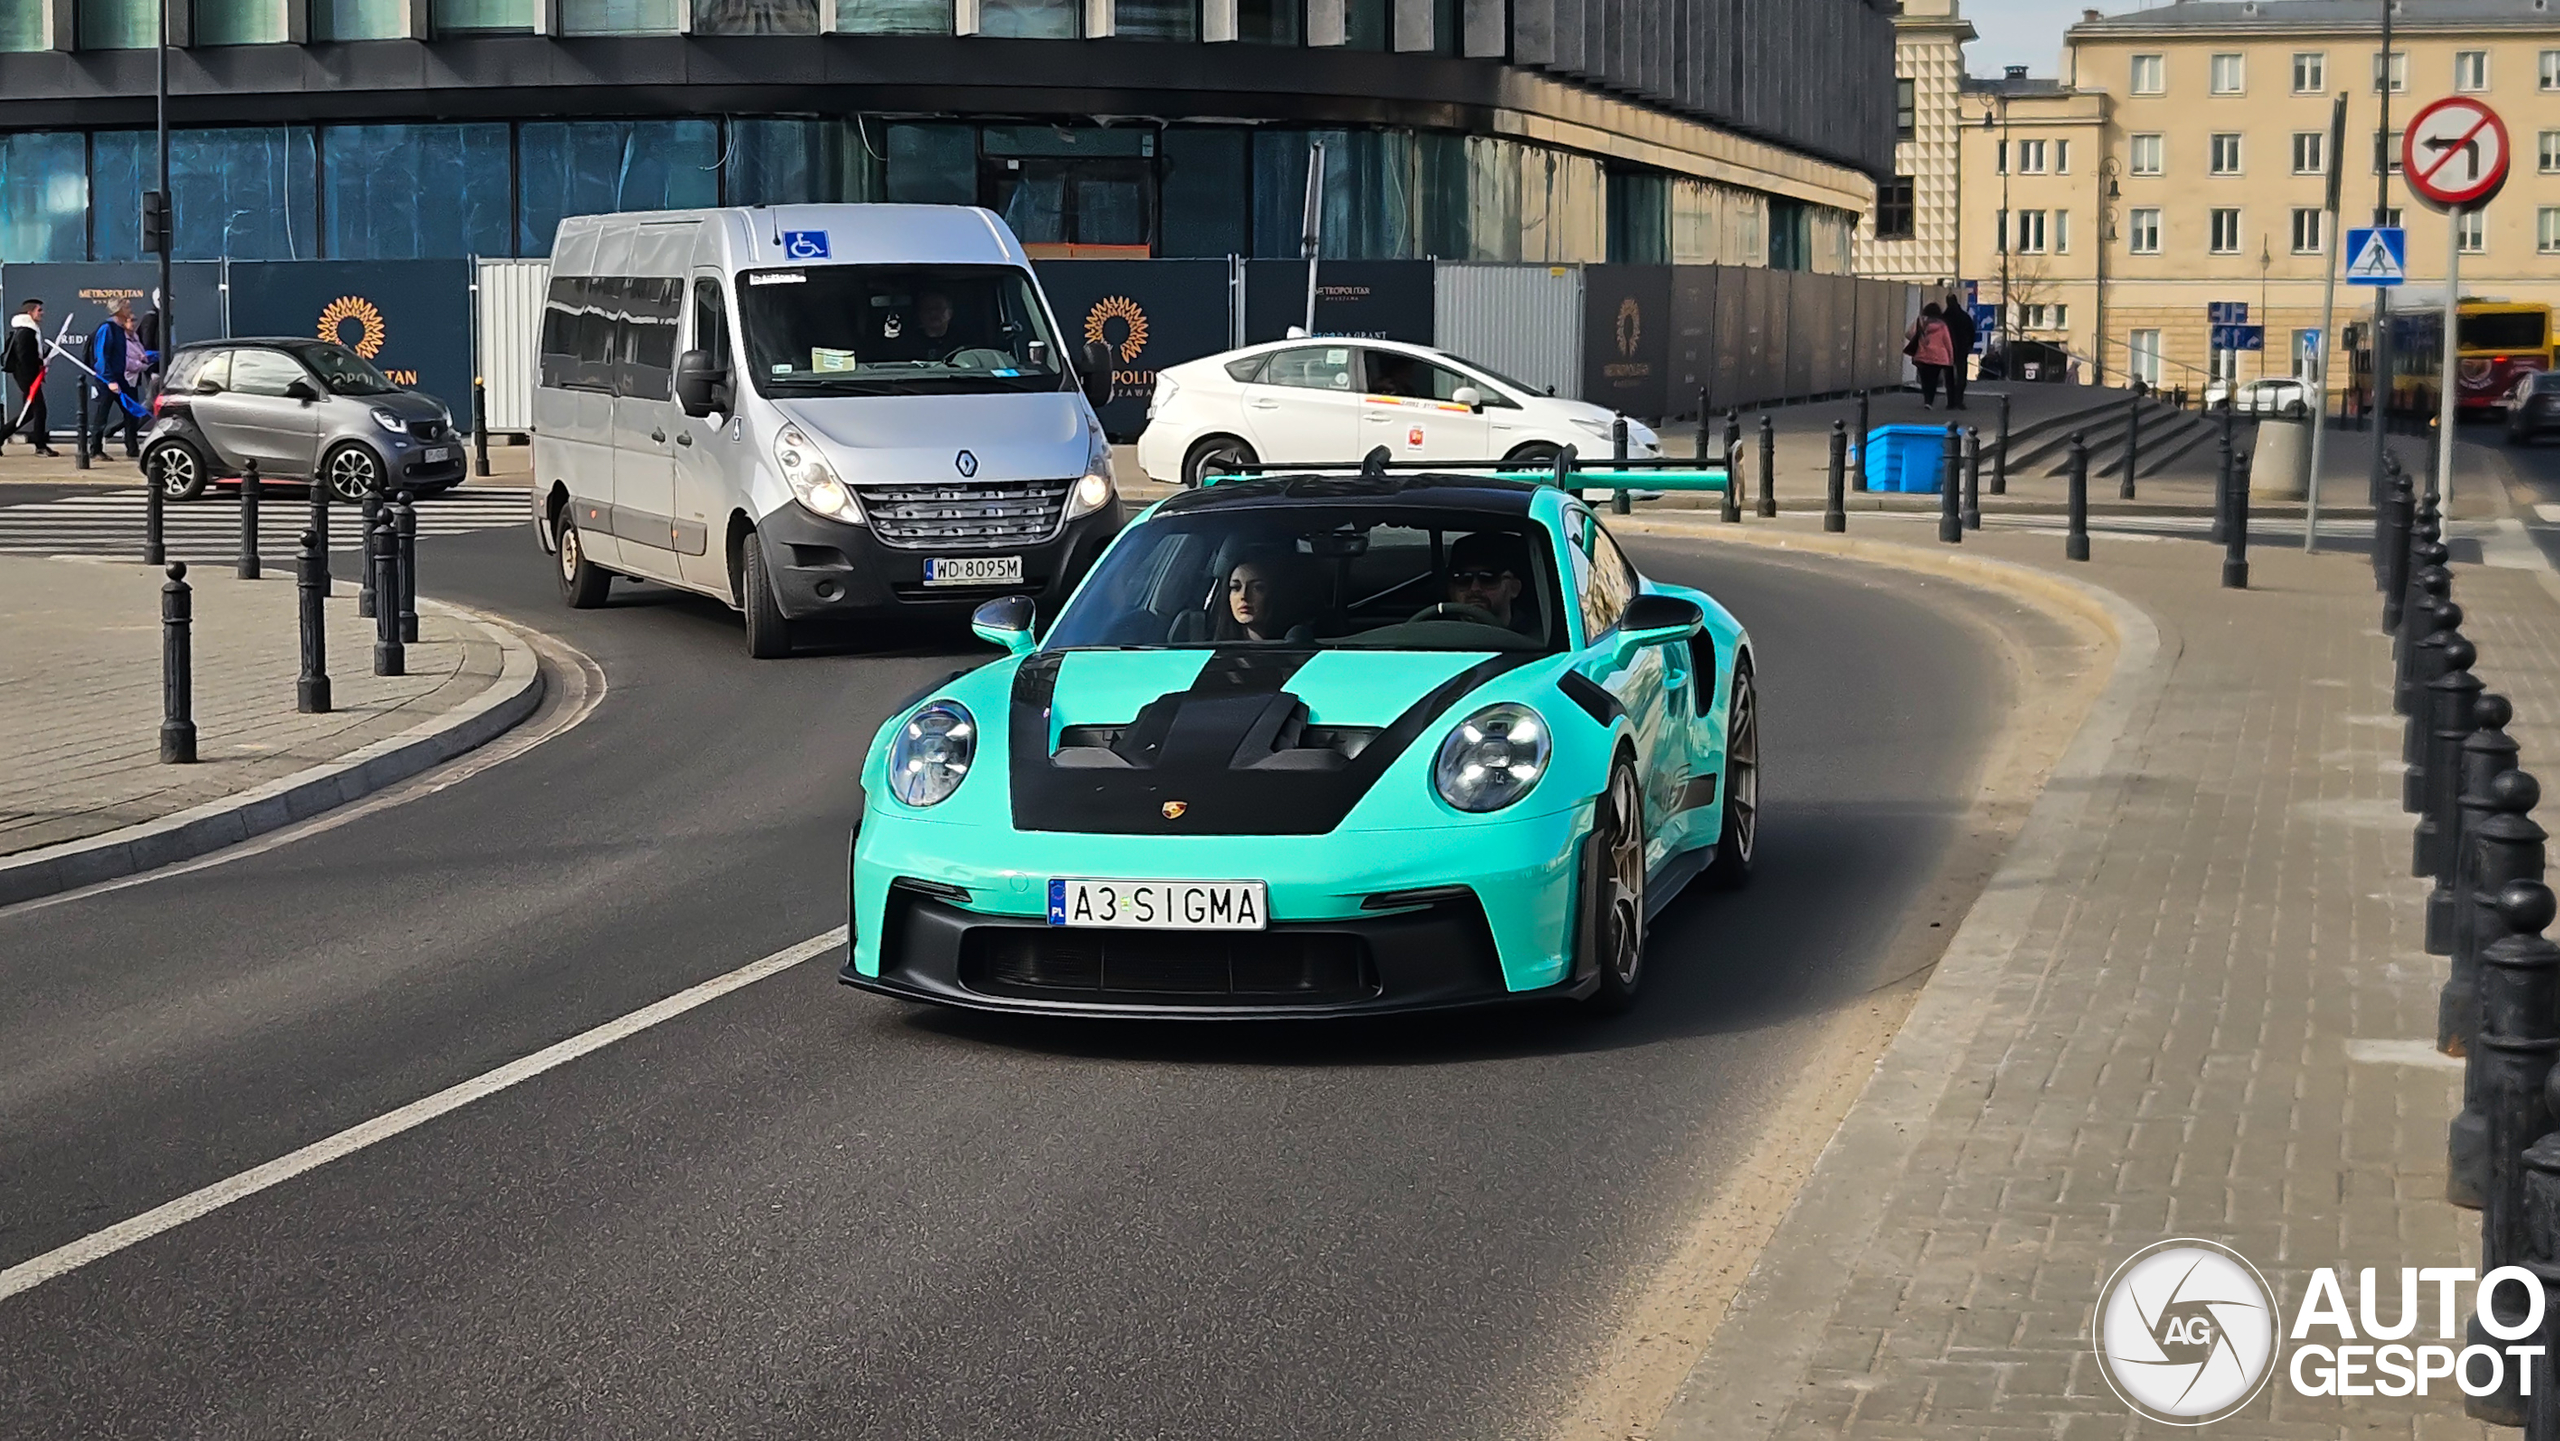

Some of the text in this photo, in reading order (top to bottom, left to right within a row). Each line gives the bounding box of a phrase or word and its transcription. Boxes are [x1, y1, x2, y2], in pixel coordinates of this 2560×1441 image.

[937, 559, 1018, 578] WD 8095M
[1051, 907, 1065, 918] PL
[1074, 885, 1257, 924] A3 SIGMA
